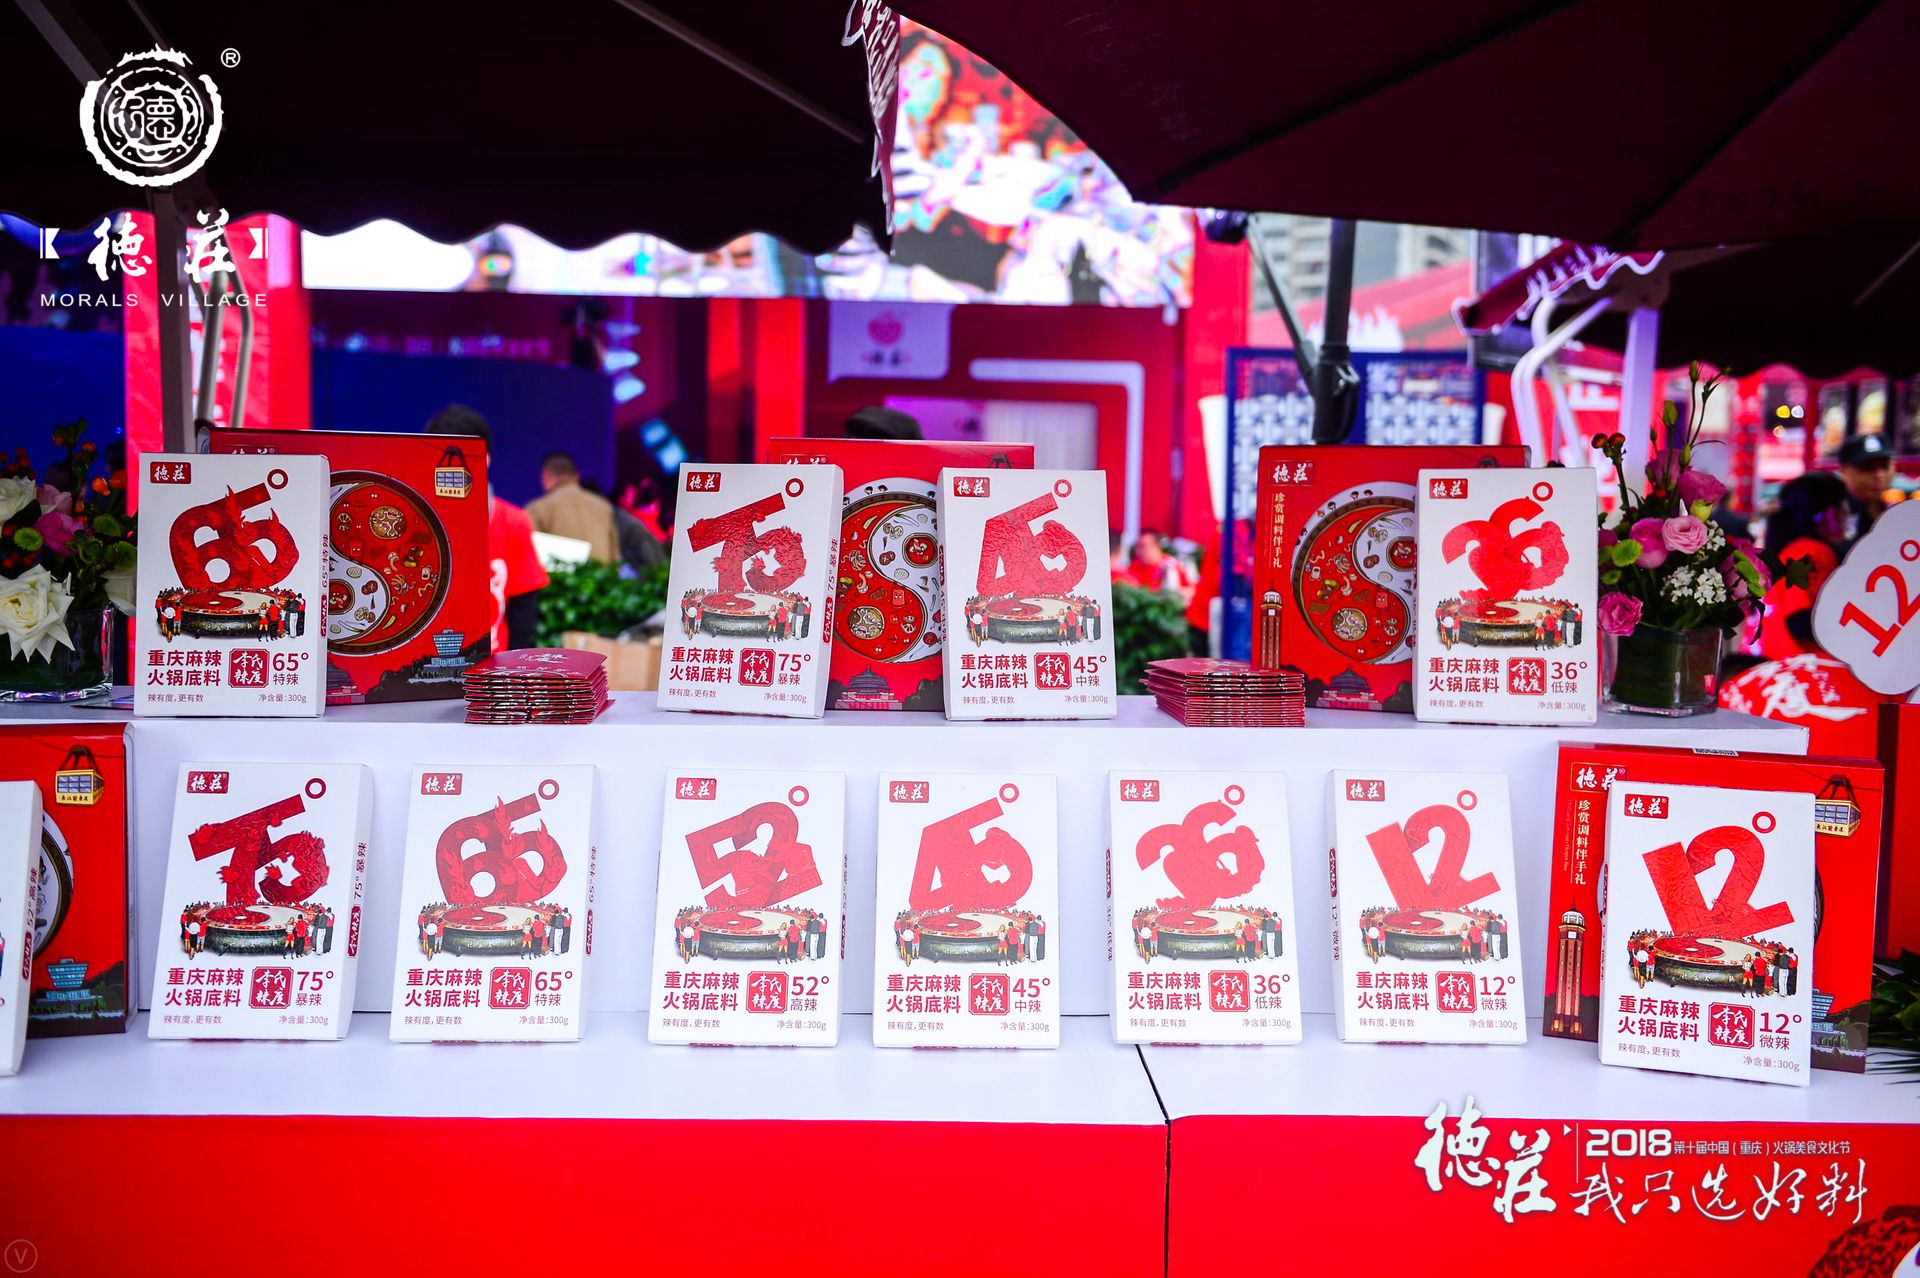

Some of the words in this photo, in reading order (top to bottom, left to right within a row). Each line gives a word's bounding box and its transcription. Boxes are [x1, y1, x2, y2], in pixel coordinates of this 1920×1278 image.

[148, 650, 222, 667] 重庆麻辣
[273, 651, 309, 672] 65°
[670, 647, 734, 664] 重庆麻辣
[778, 653, 811, 672] 75°
[961, 654, 1028, 670] 重庆麻辣
[1074, 654, 1107, 674] 45°
[1428, 657, 1499, 674] 重庆麻辣
[1551, 661, 1587, 681] 36°
[147, 669, 221, 687] 火锅底料
[273, 673, 299, 686] 特辣
[669, 667, 732, 683] 火锅底料
[778, 673, 800, 685] 暴辣
[961, 672, 1028, 689] 火锅底料
[1076, 675, 1100, 687] 中辣
[1428, 676, 1499, 693] 火锅底料
[1551, 682, 1578, 694] 低辣
[1575, 799, 1591, 885] 珍赏调料伴手礼
[167, 967, 244, 986] 重庆麻辣
[297, 970, 334, 992] 75°
[406, 968, 483, 986] 重庆麻辣
[534, 970, 573, 992] 65°
[664, 971, 740, 990] 重庆麻辣
[886, 974, 961, 992] 重庆麻辣
[1127, 971, 1201, 989] 重庆麻辣
[1253, 973, 1291, 995] 36°
[1356, 971, 1428, 989] 重庆麻辣
[1480, 975, 1516, 996] 12°
[791, 975, 830, 997] 52°
[1012, 977, 1050, 998] 45°
[164, 988, 241, 1007] 火锅底料
[296, 993, 322, 1006] 暴辣
[404, 989, 481, 1008] 火锅底料
[534, 993, 561, 1006] 特辣
[662, 992, 738, 1011] 火锅底料
[790, 998, 818, 1012] 高辣
[886, 995, 961, 1014] 火锅底料
[1014, 1000, 1041, 1013] 中辣
[1128, 992, 1202, 1011] 火锅底料
[1254, 996, 1283, 1009] 低辣
[1357, 992, 1429, 1011] 火锅底料
[1481, 998, 1508, 1011] 微辣
[1617, 994, 1700, 1020] 重庆麻辣
[1617, 1018, 1700, 1042] 火锅底料
[1759, 1010, 1802, 1035] 12°
[1759, 1035, 1790, 1051] 微辣
